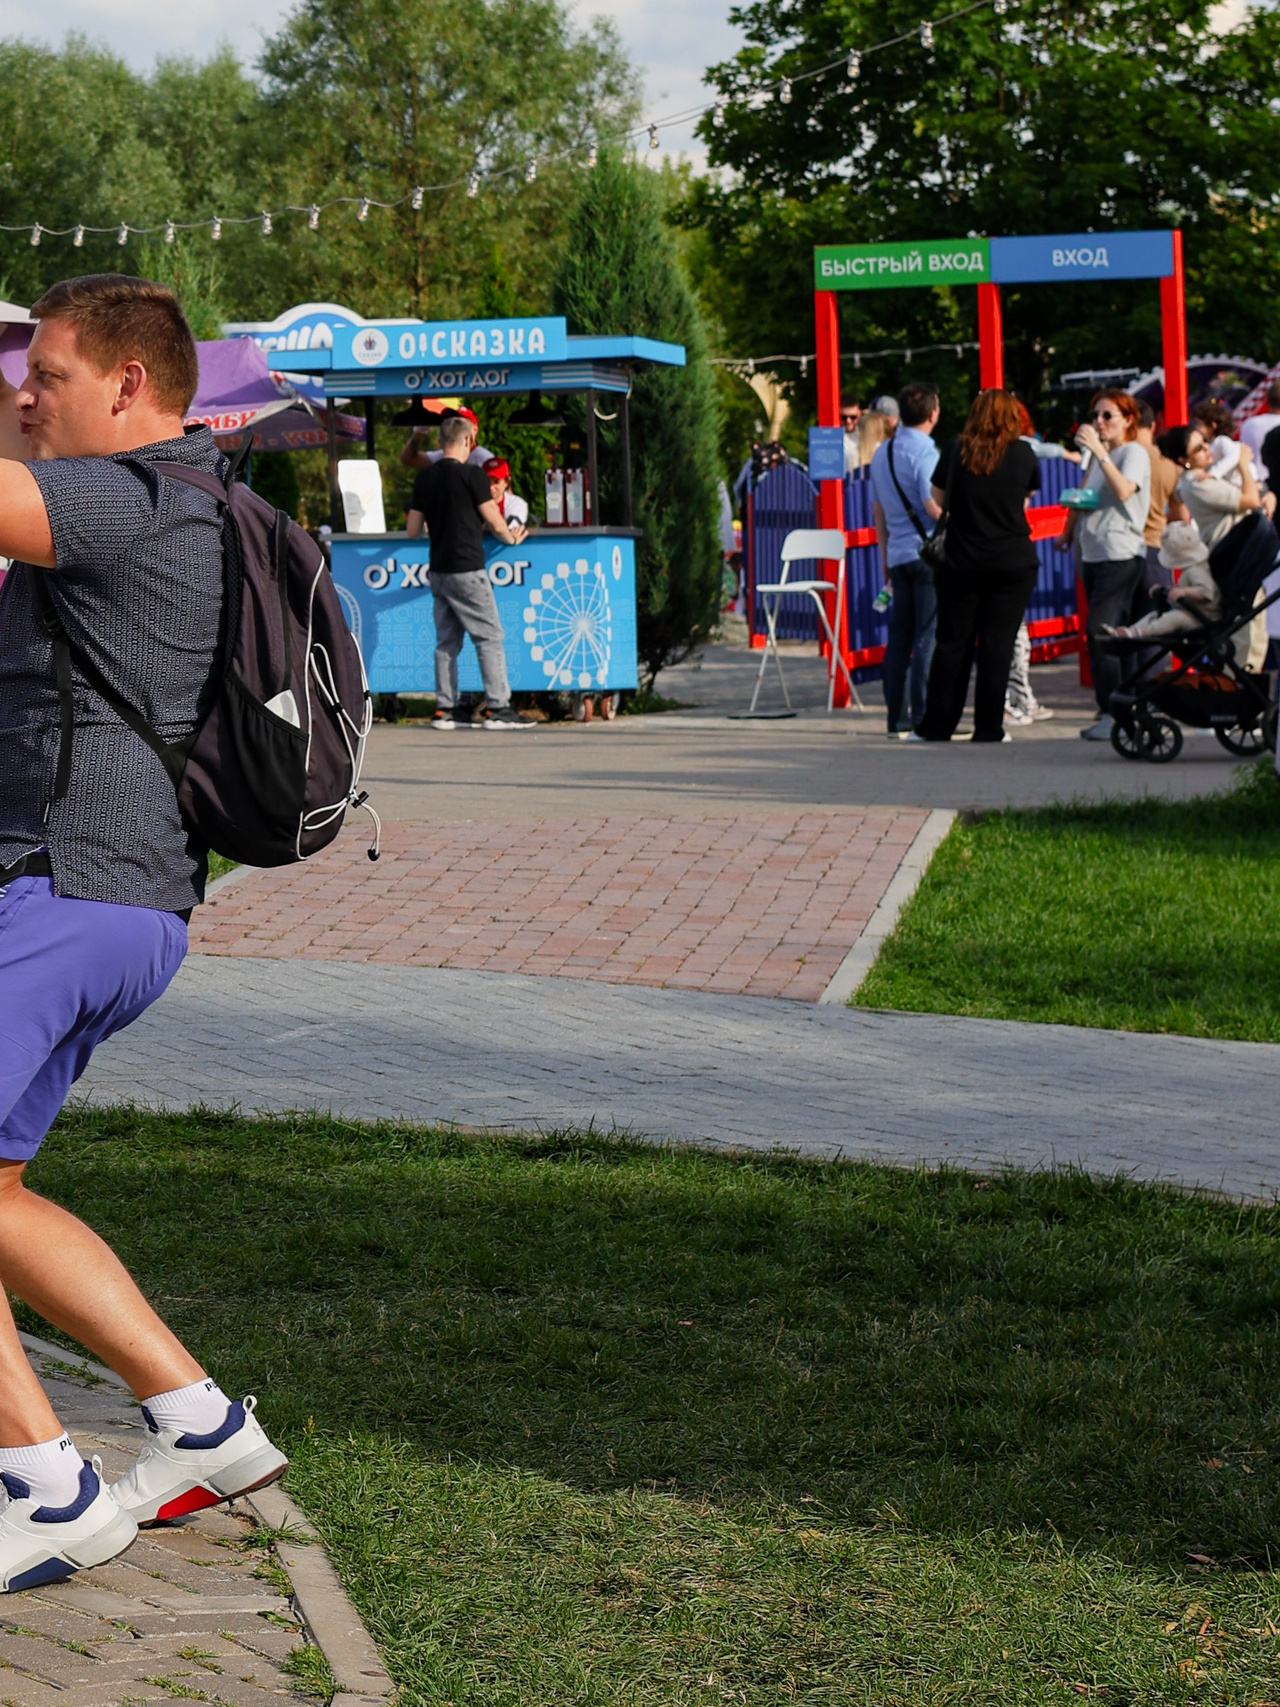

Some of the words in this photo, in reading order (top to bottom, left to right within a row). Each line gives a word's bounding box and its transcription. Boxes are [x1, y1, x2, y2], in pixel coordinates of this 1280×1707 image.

[821, 251, 922, 277] БЫСТРЫЙ
[928, 252, 984, 272] ВХОД
[1052, 248, 1109, 268] ВХОД
[469, 368, 512, 389] ДОГ
